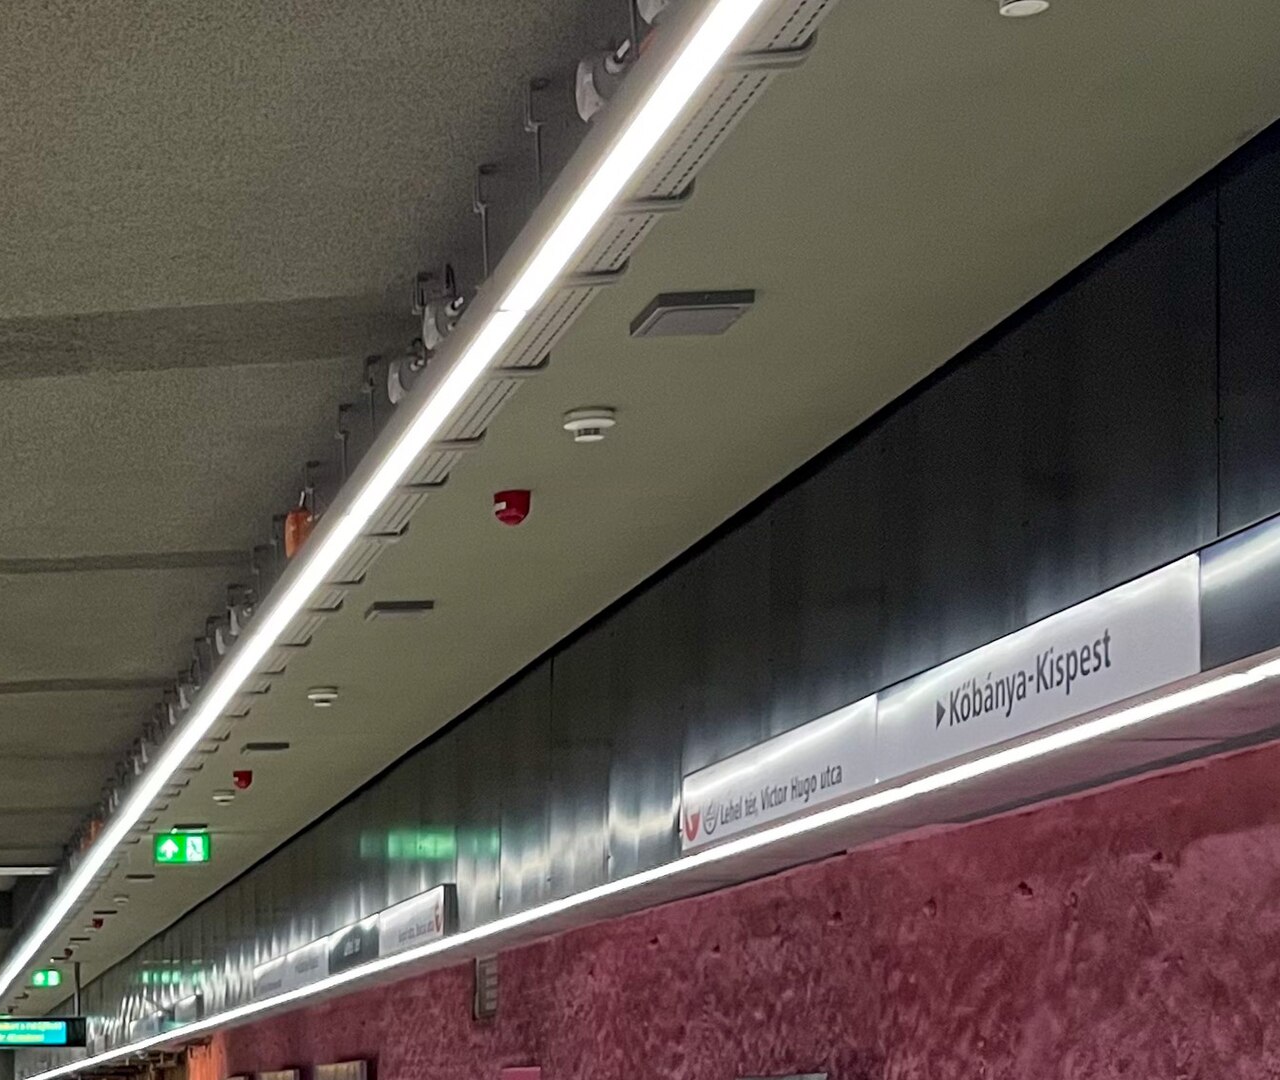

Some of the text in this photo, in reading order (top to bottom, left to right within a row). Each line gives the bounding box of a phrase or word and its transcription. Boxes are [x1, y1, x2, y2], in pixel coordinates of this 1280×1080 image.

[949, 628, 1112, 727] Kőbánya-Kispest
[720, 765, 843, 825] Lehel tér, Victor Hugo utca
